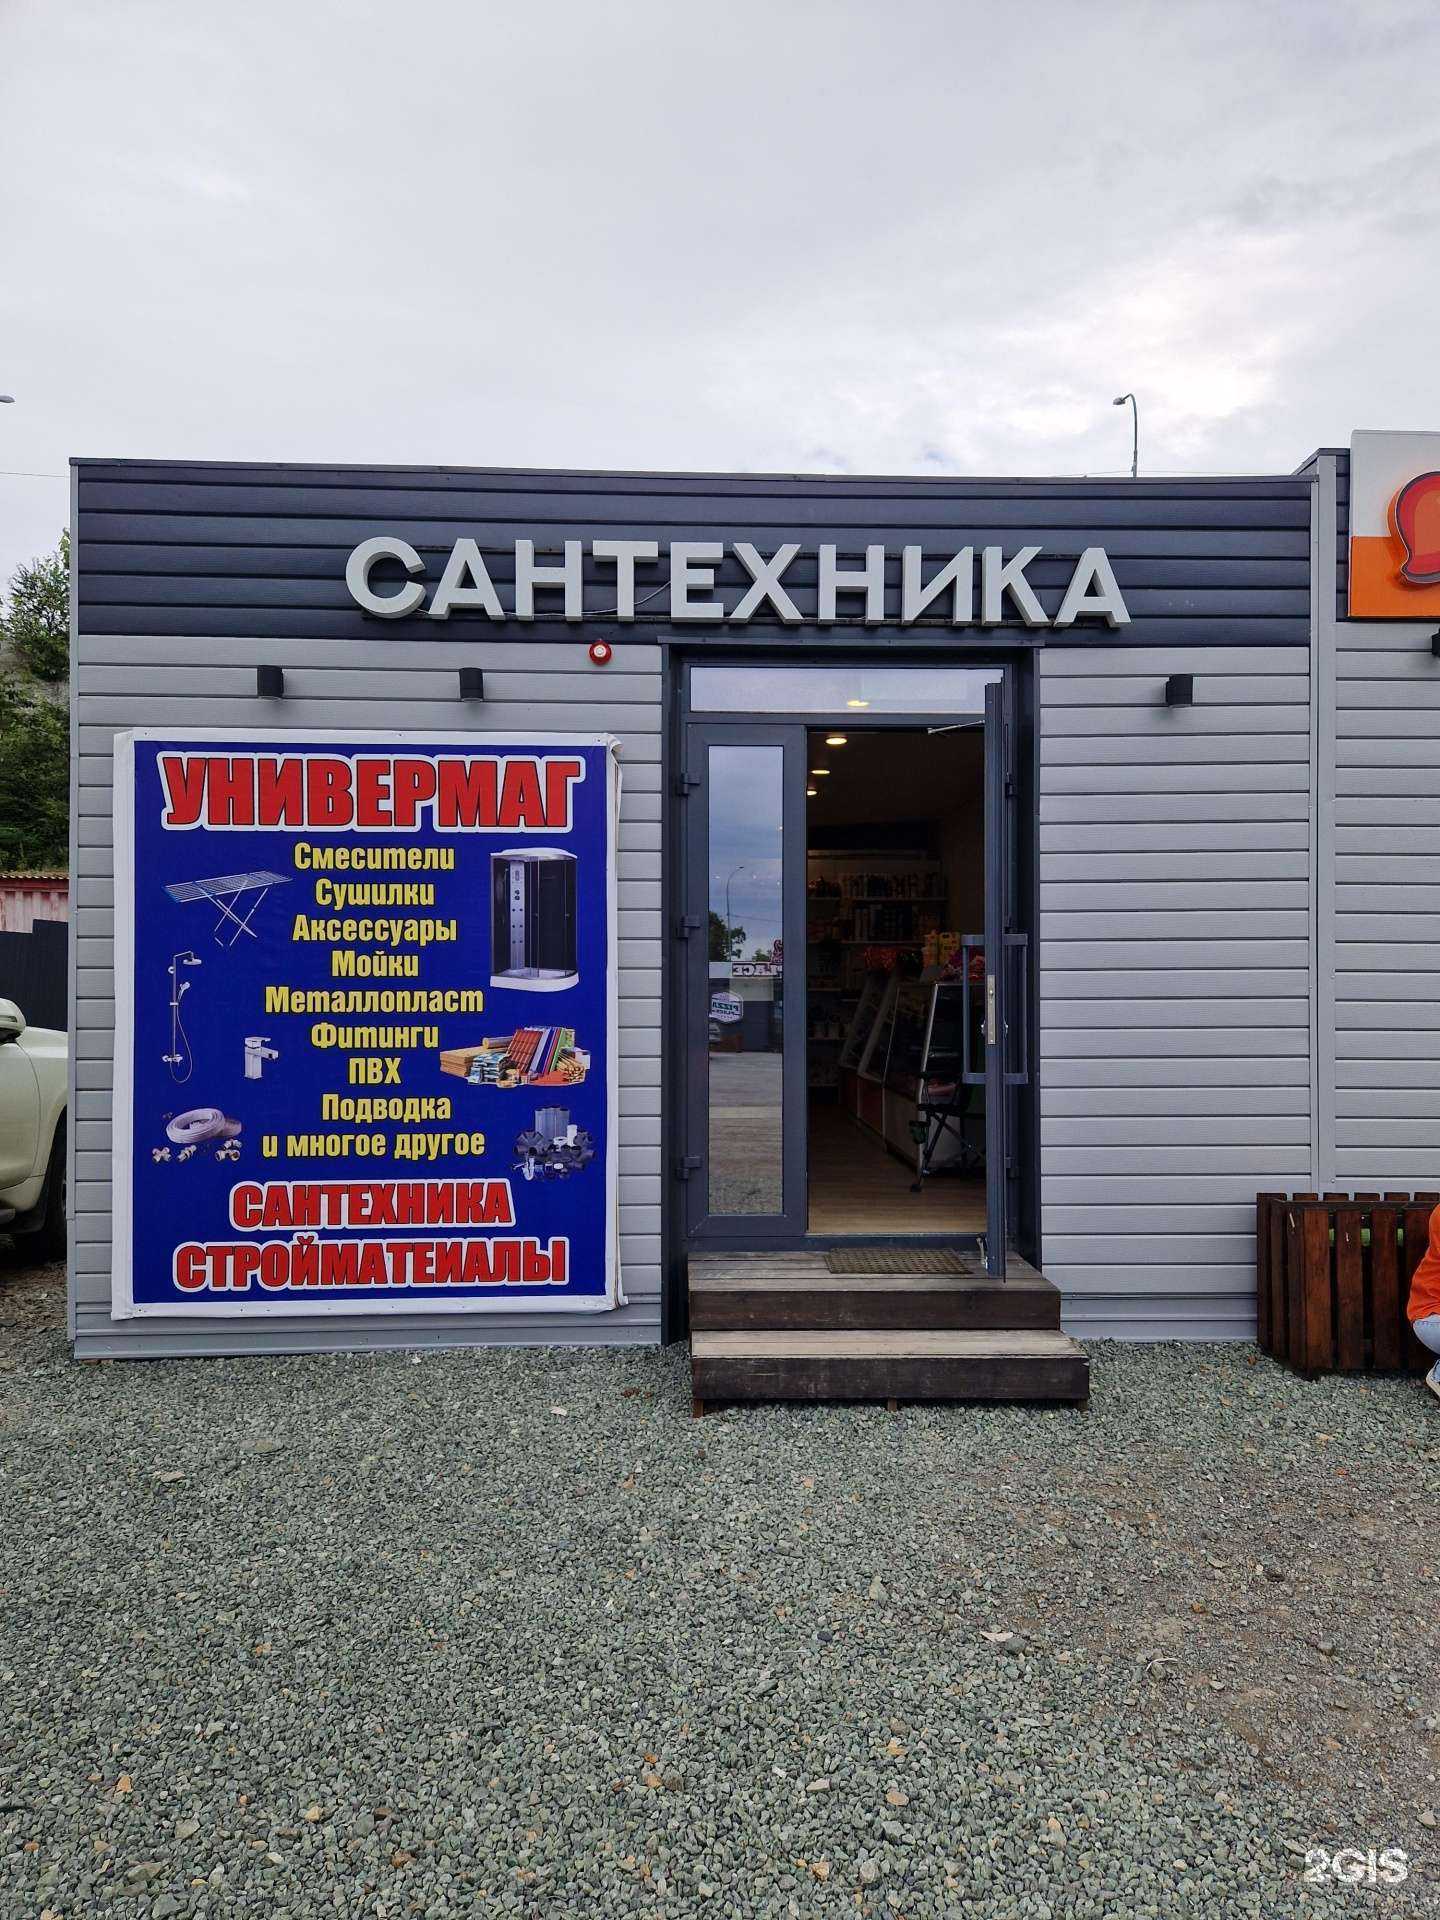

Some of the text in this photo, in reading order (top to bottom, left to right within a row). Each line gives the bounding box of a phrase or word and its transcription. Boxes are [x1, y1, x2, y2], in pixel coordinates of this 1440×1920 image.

[345, 536, 1132, 627] САНТЕХНИКА
[161, 756, 582, 829] УНИВЕРМАГ
[294, 842, 455, 871] Смесители
[315, 878, 435, 908] Сушилки
[292, 914, 457, 944] Аксессуары
[331, 950, 419, 977] Мойки
[265, 985, 484, 1013] Металлопласт
[311, 1022, 439, 1049] Фитинги
[348, 1058, 401, 1085] ПВХ
[321, 1093, 451, 1122] Подводка
[262, 1132, 485, 1161] и многое другое
[233, 1182, 513, 1227] САНТЕХНИКА
[176, 1236, 567, 1288] СТРОЙМАТЕИАЛЫ
